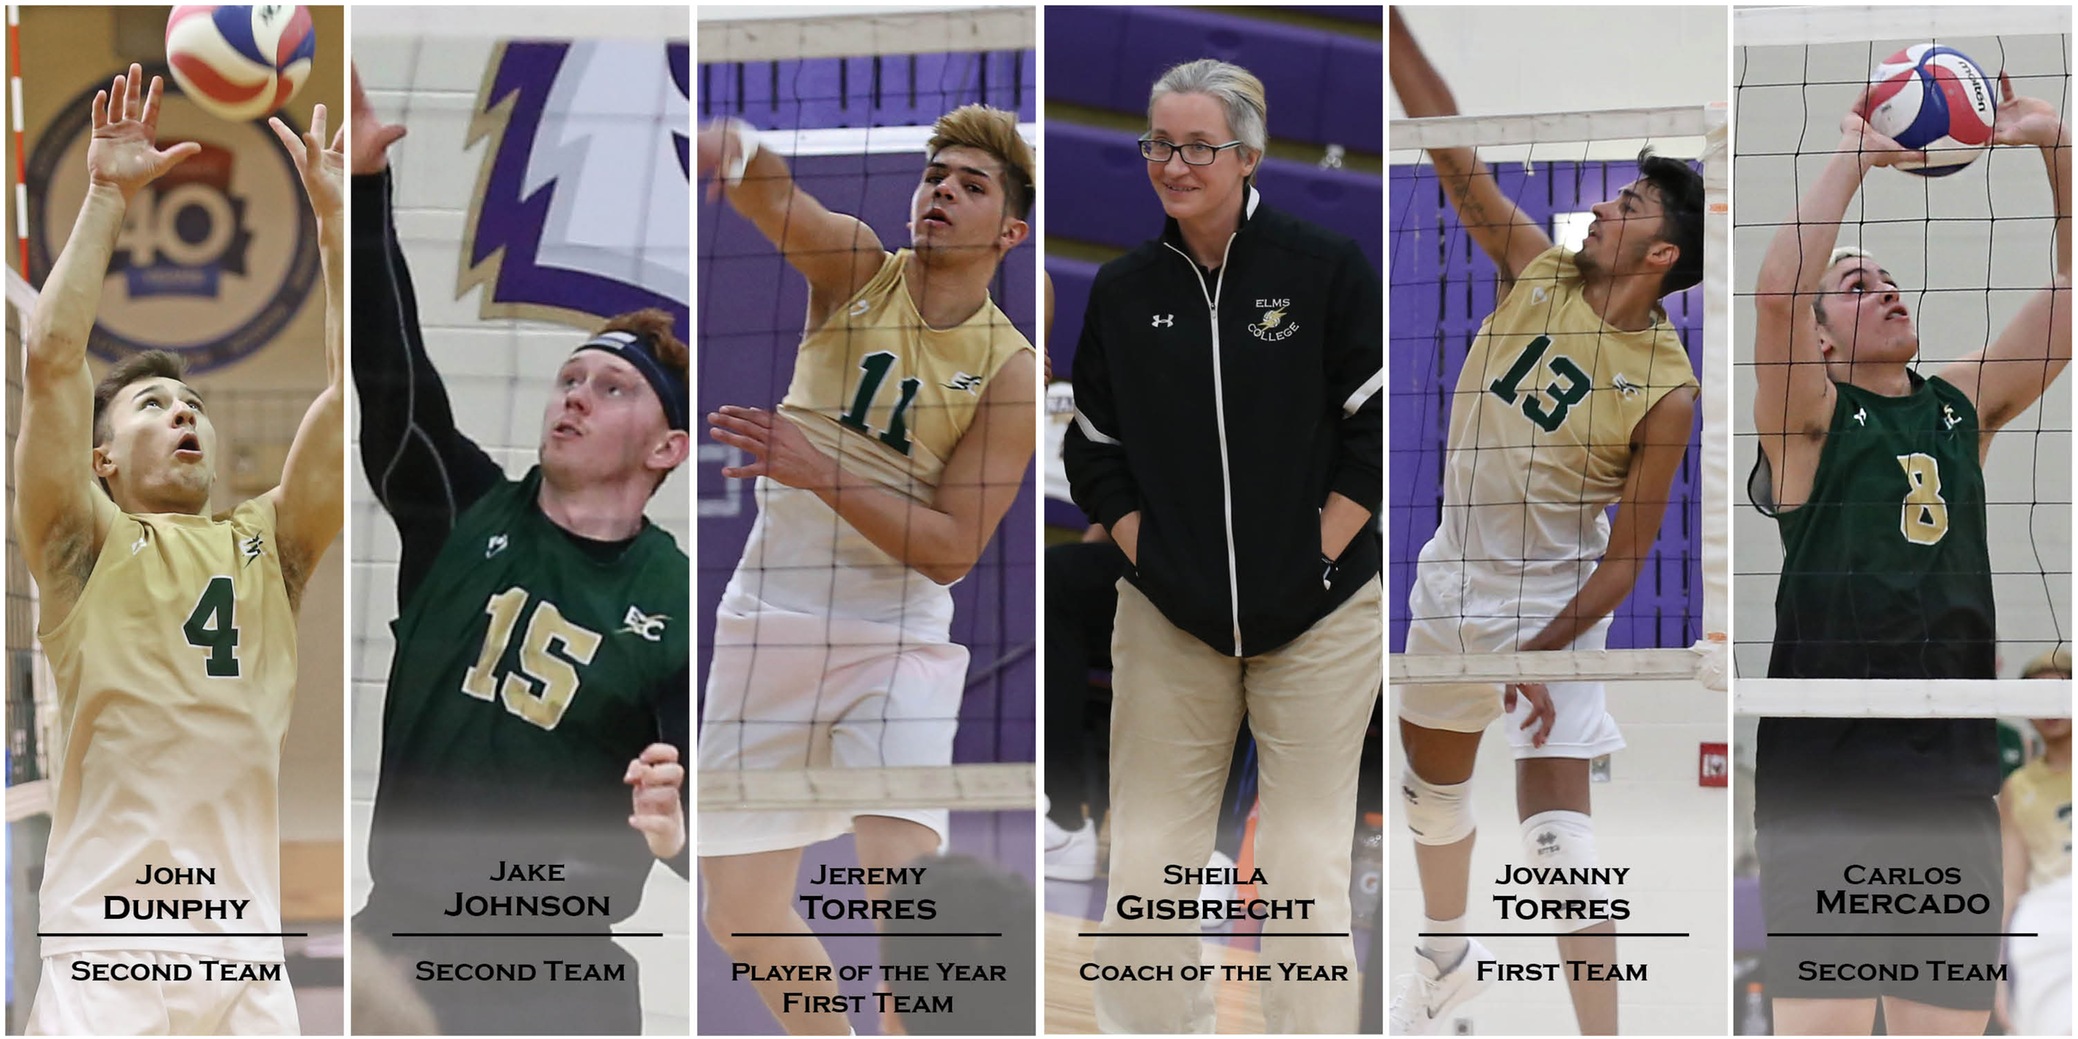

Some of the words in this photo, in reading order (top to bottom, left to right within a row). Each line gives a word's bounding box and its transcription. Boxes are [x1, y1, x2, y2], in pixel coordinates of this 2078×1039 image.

[1958, 61, 1986, 112] molten
[114, 182, 235, 267] 40
[1247, 321, 1300, 342] COLLEGE
[1254, 298, 1291, 309] ELMS
[841, 350, 923, 459] 11
[1489, 333, 1593, 433] 13
[1896, 452, 1949, 546] 8
[182, 574, 242, 679] 4
[461, 586, 603, 732] 15
